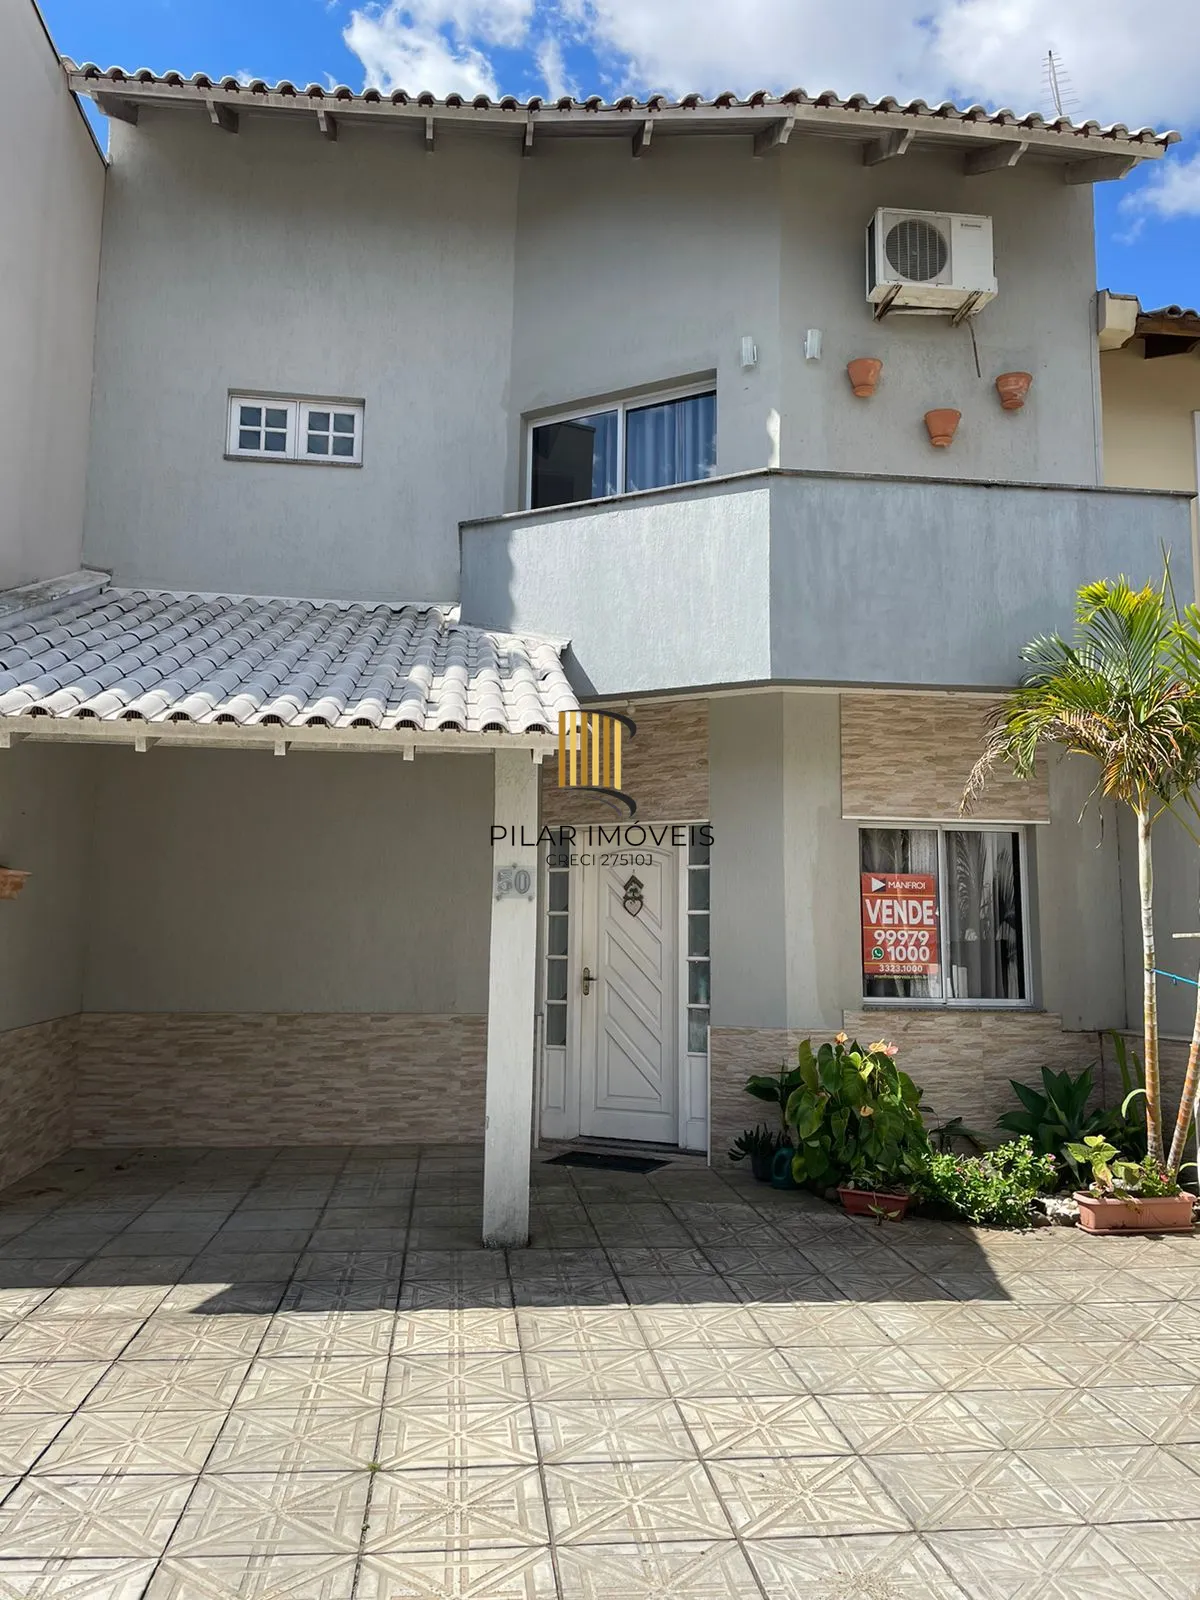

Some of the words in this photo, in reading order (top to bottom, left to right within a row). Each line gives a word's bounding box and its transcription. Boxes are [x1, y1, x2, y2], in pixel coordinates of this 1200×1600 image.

[496, 869, 531, 895] 50
[888, 881, 926, 890] MANFROI
[865, 899, 935, 925] VENDE
[874, 930, 930, 946] 99979
[887, 946, 930, 962] 1000
[880, 964, 923, 973] 3323.1000
